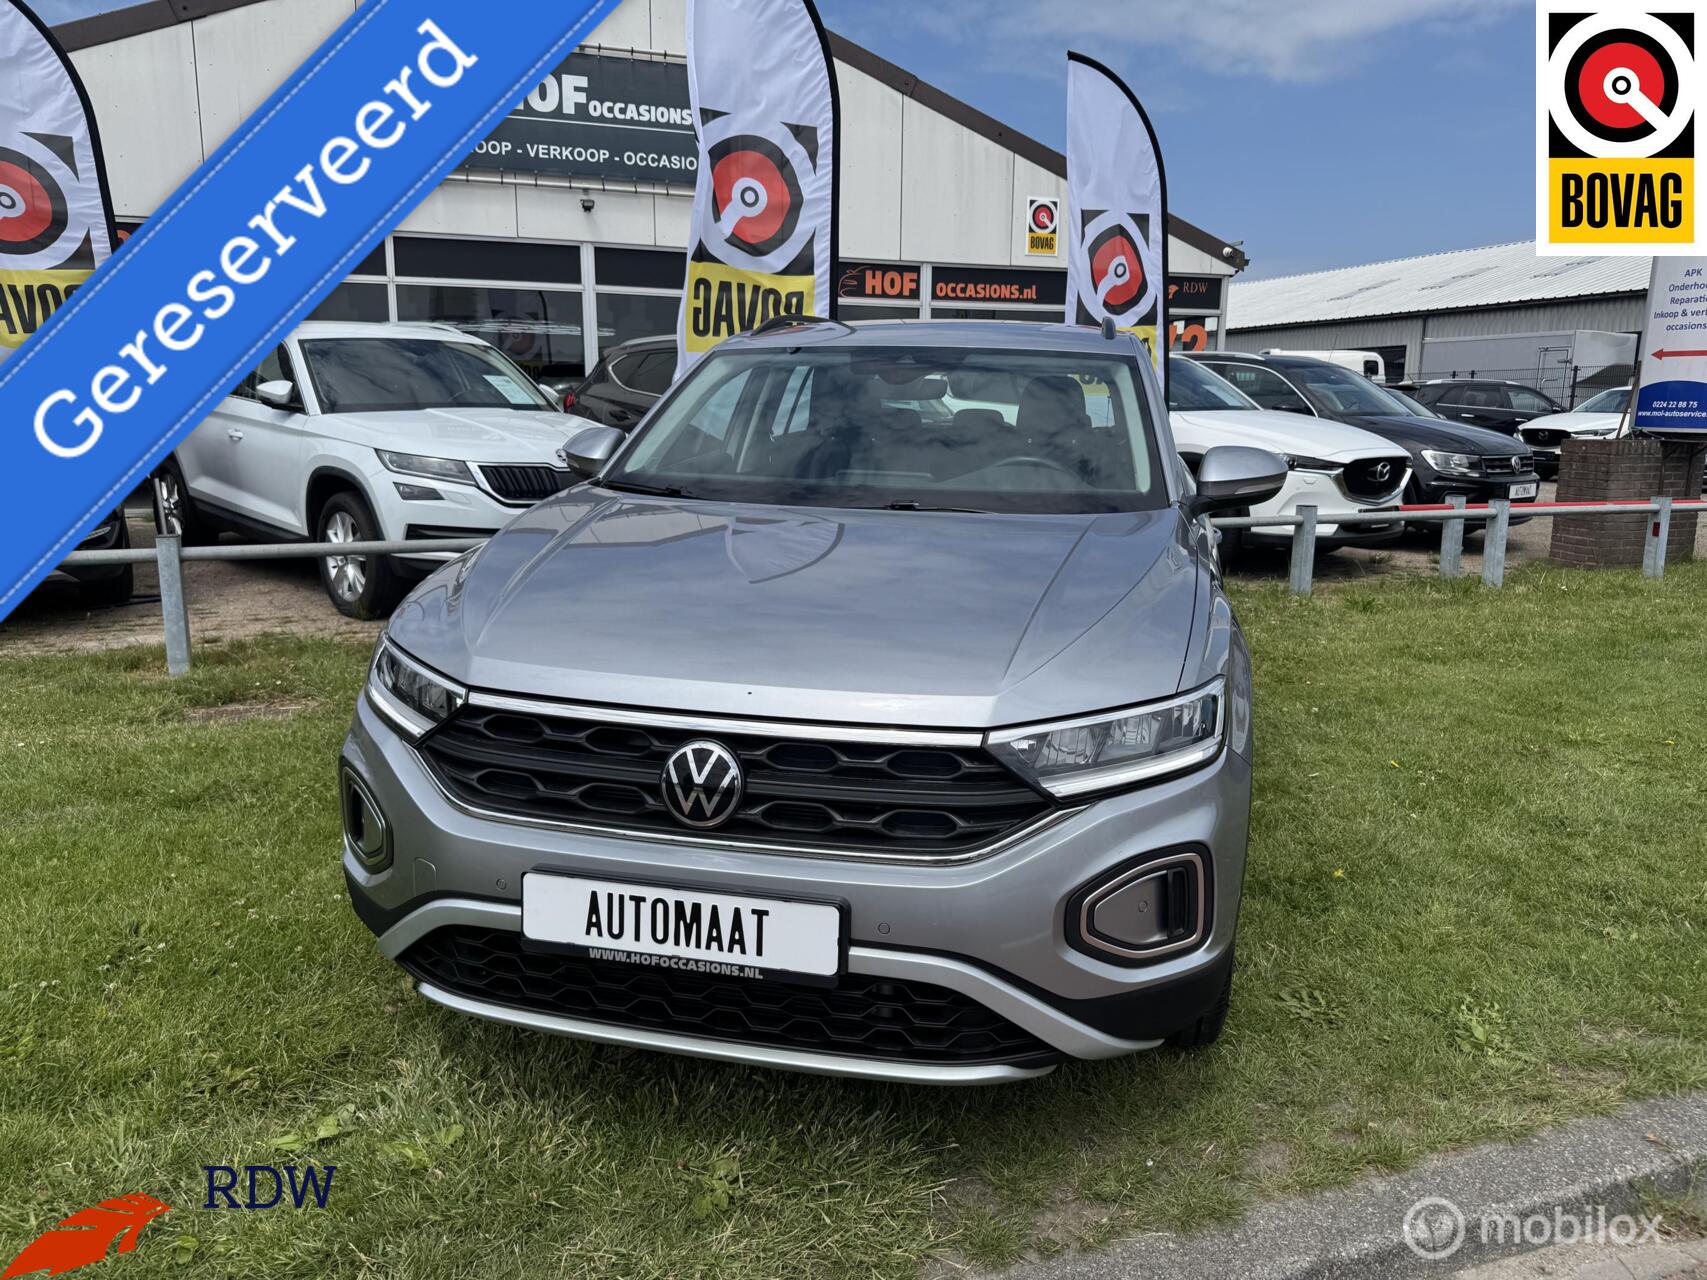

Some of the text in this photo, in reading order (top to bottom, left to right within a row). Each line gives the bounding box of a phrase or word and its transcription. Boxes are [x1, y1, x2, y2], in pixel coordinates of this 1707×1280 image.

[513, 73, 693, 125] OF OCCASIONS
[470, 140, 512, 155] OOP
[526, 143, 609, 163] VERKOOP
[1030, 235, 1054, 250] BOVAG
[1684, 267, 1703, 278] APK
[864, 270, 1037, 300] HOF OCCASIONS.nl
[1183, 281, 1208, 293] RDW
[1668, 281, 1707, 292] Onderho
[1669, 294, 1707, 306] Reparati
[1653, 310, 1679, 319] Inkoop
[1680, 308, 1688, 317] &
[1665, 321, 1707, 331] occasions
[1652, 400, 1668, 408] 0224
[585, 890, 770, 957] AUTOMAAT
[588, 947, 764, 980] WWW.HOFOCCASIONS.NL
